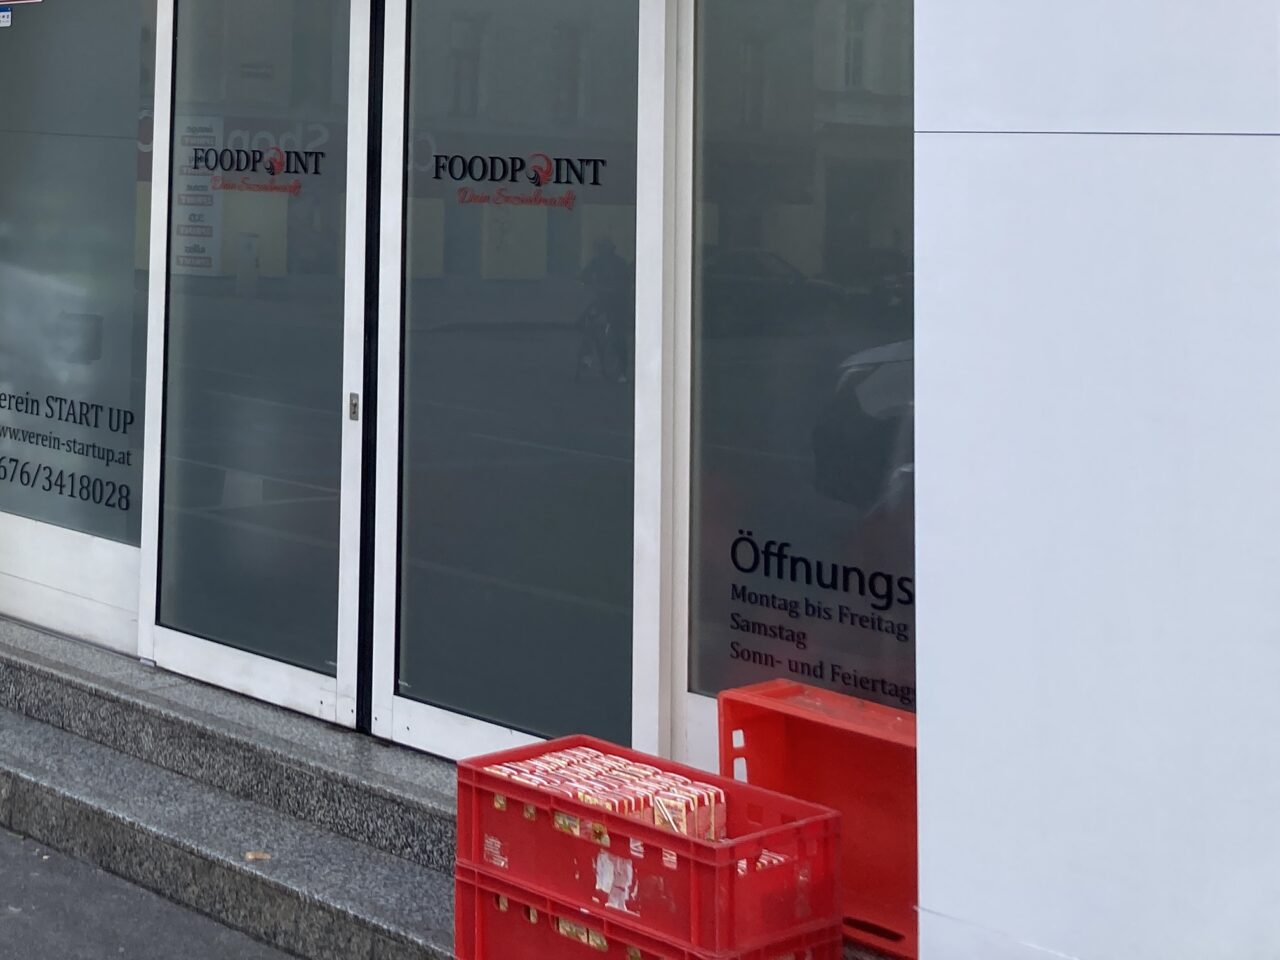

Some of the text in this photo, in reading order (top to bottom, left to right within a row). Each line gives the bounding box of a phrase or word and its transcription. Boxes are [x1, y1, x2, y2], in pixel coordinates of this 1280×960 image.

[45, 395, 103, 429] START
[108, 407, 135, 434] UP
[730, 528, 914, 611] Öffnungs
[730, 583, 910, 642] Montag bis Freitag
[730, 612, 808, 650] Samstag
[730, 641, 915, 705] Sonn- und Feiertag
